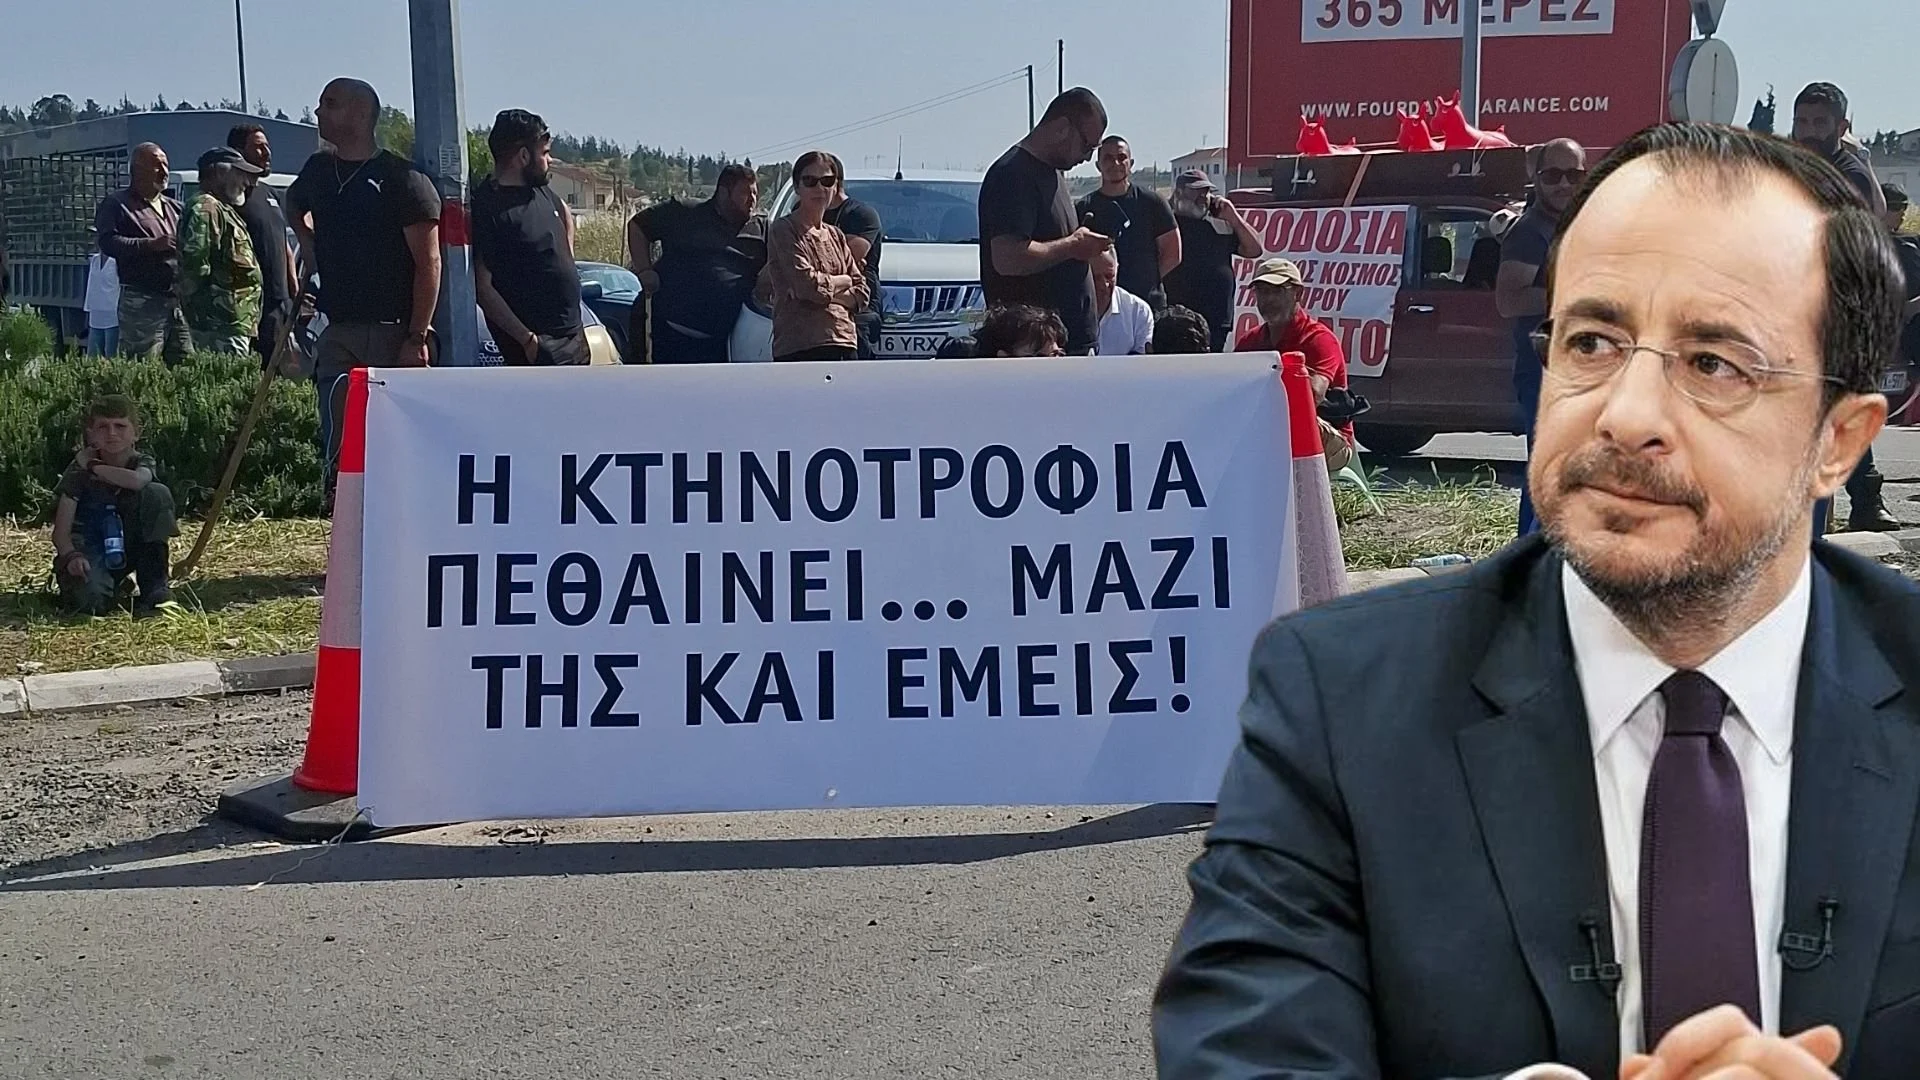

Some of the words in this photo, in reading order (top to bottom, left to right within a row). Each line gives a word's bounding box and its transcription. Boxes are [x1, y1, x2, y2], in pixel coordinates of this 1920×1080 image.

[1237, 209, 1407, 255] ΡΟΔΟΣΙΑ
[1319, 261, 1402, 286] ΚΟΣΜΟΣ
[900, 336, 938, 352] YRX
[457, 454, 511, 525] Η
[560, 440, 1208, 525] ΚΤΗΝΟΤΡΟΦΙΑ
[427, 549, 968, 628] ΠΕΘΑΙΝΕΙ...
[1011, 537, 1230, 616] ΜΑΖΙ
[472, 654, 640, 729] ΤΗΣ
[686, 651, 835, 726] ΚΑΙ
[887, 636, 1191, 719] ΕΜΕΙΣ!
